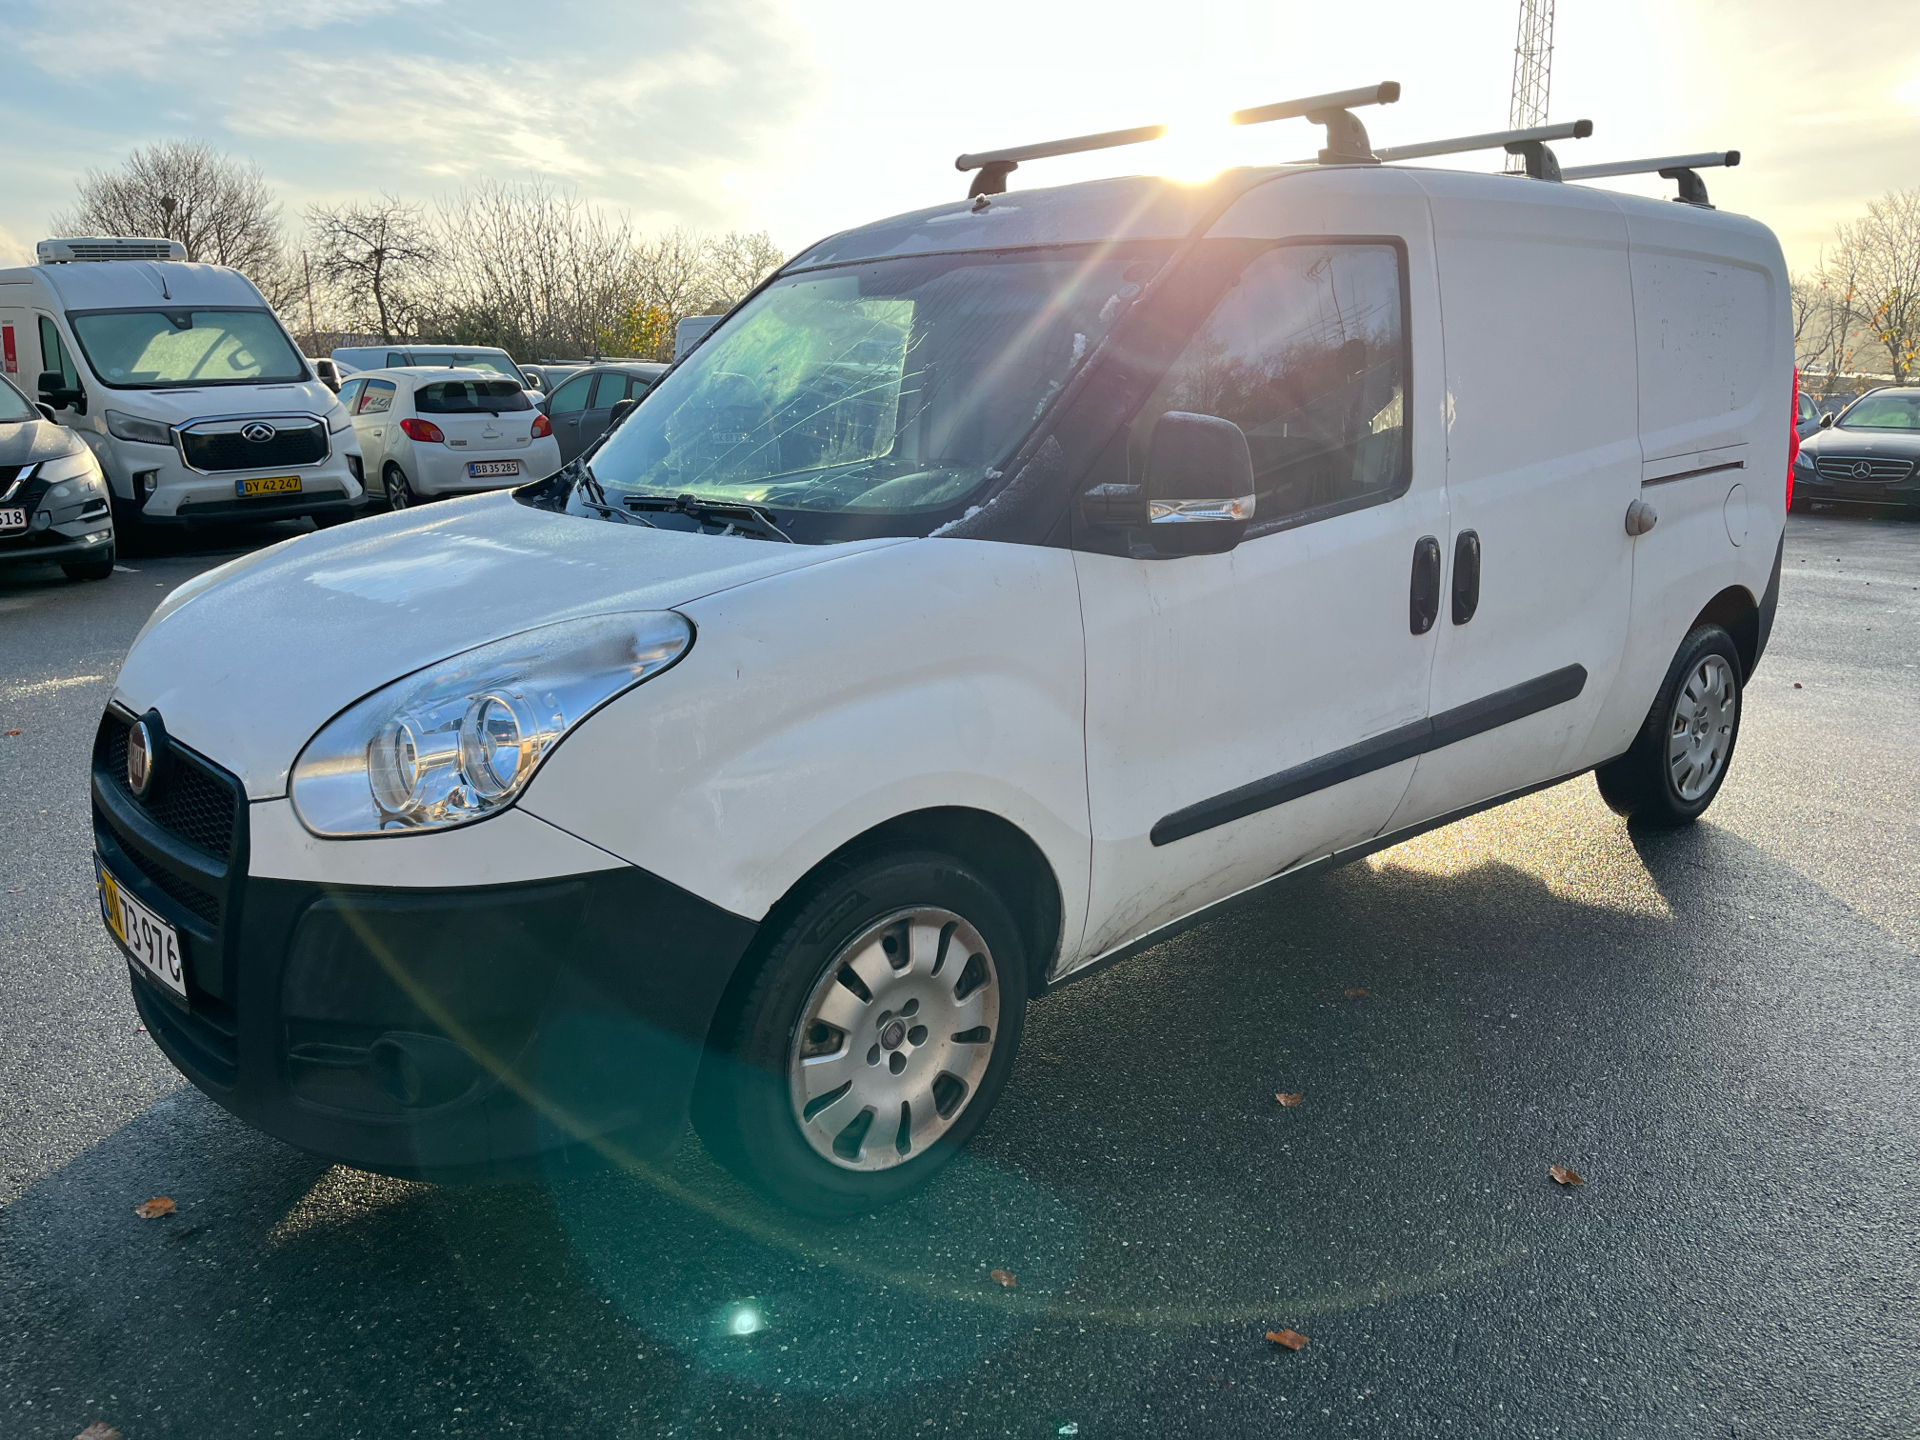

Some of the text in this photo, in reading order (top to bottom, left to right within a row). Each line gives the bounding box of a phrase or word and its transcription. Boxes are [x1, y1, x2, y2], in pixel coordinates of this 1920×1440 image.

[475, 463, 517, 474] BB 35 285
[245, 478, 299, 492] DY 42 247
